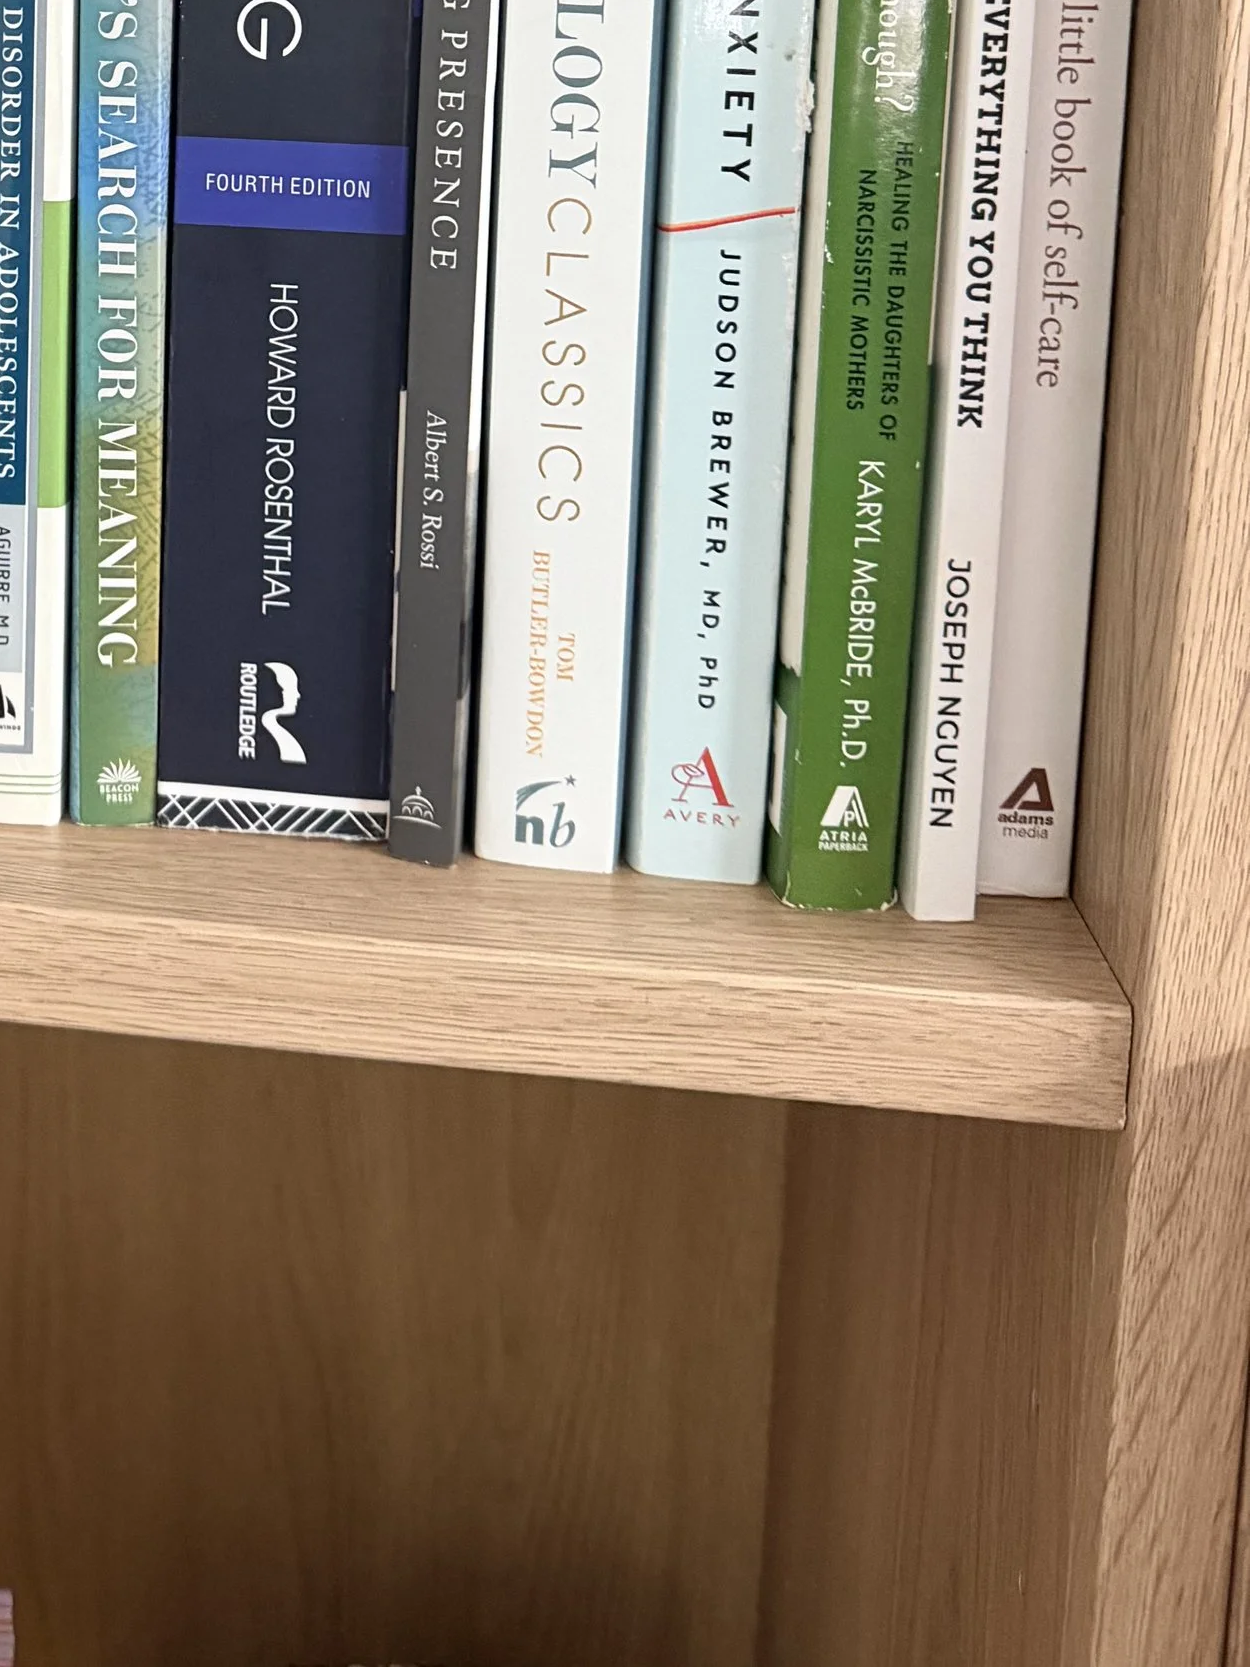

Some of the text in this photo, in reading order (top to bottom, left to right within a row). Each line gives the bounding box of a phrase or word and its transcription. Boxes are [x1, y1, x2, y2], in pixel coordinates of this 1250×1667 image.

[1055, 1, 1099, 85] little
[97, 59, 139, 279] SEARCH
[205, 173, 371, 199] FOURTH EDITION
[429, 29, 468, 271] PRESENCE
[1049, 98, 1092, 187] book
[964, 231, 995, 305] YOU
[1046, 197, 1083, 240] of
[846, 169, 877, 411] NARCISSISTIC MOTHERS
[878, 141, 915, 442] HEALING THE DAUGHTERS OF
[1035, 244, 1081, 389] self-care
[97, 295, 139, 403] FOR
[536, 197, 593, 522] CLASSICS
[956, 313, 991, 429] THINK
[261, 284, 299, 616] HOWARD ROSENTHAL
[419, 409, 448, 570] Albert Rossi
[697, 249, 742, 640] JUDSON BREWER, MD,
[97, 419, 139, 668] MEANING
[525, 549, 550, 758] BUTLER-BOWDON
[556, 632, 575, 682] TOM
[839, 460, 885, 768] KARYL Ph.D.
[238, 662, 258, 761] ROUTLEDGE
[929, 559, 971, 828] JOSEPH NGUYEN
[99, 783, 140, 794] BEACON
[105, 793, 134, 804] PRESS
[663, 809, 740, 828] AVERY
[819, 829, 868, 842] ATRIA
[998, 811, 1054, 826] adams
[1003, 825, 1049, 840] media
[818, 840, 869, 852] PAPERBACK
